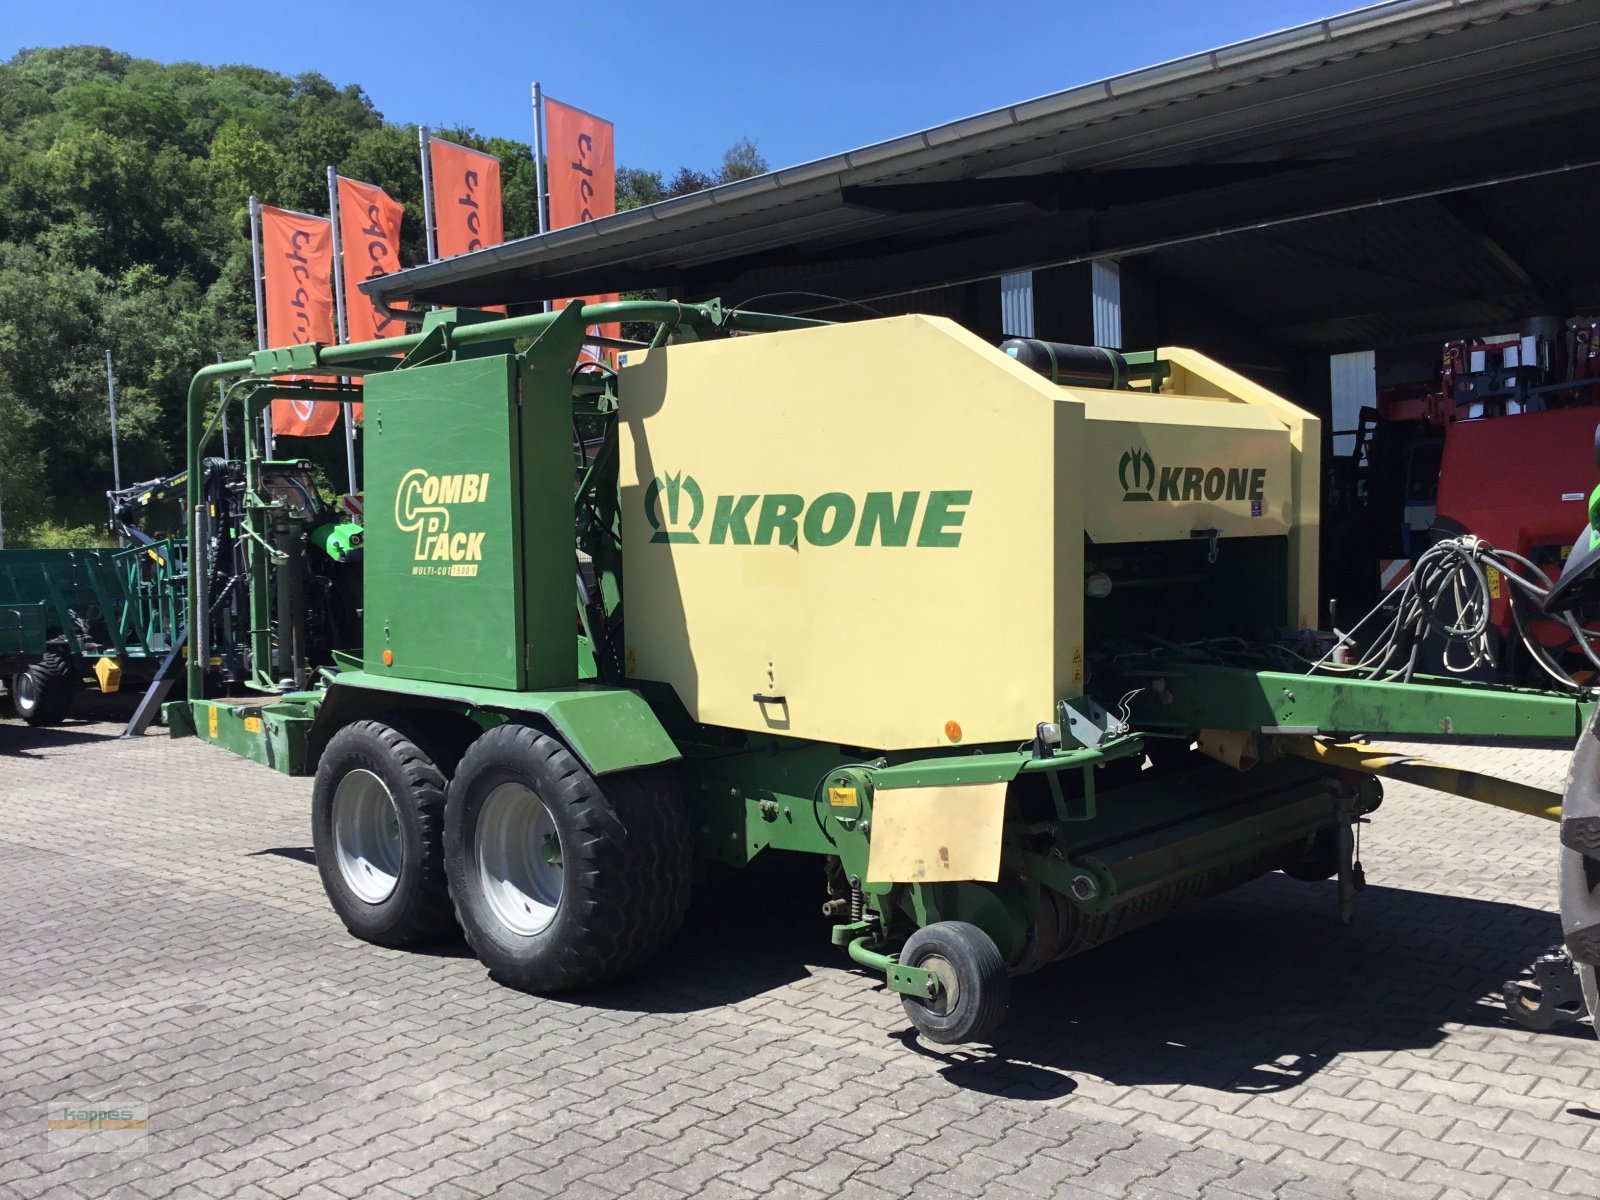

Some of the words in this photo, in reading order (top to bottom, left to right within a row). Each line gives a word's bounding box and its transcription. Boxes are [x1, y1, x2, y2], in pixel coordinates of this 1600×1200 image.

[395, 468, 490, 532] COMBI
[1158, 466, 1267, 502] KRONE
[415, 507, 486, 561] PACK
[708, 490, 974, 548] KRONE
[412, 566, 452, 575] MULTI-CUT
